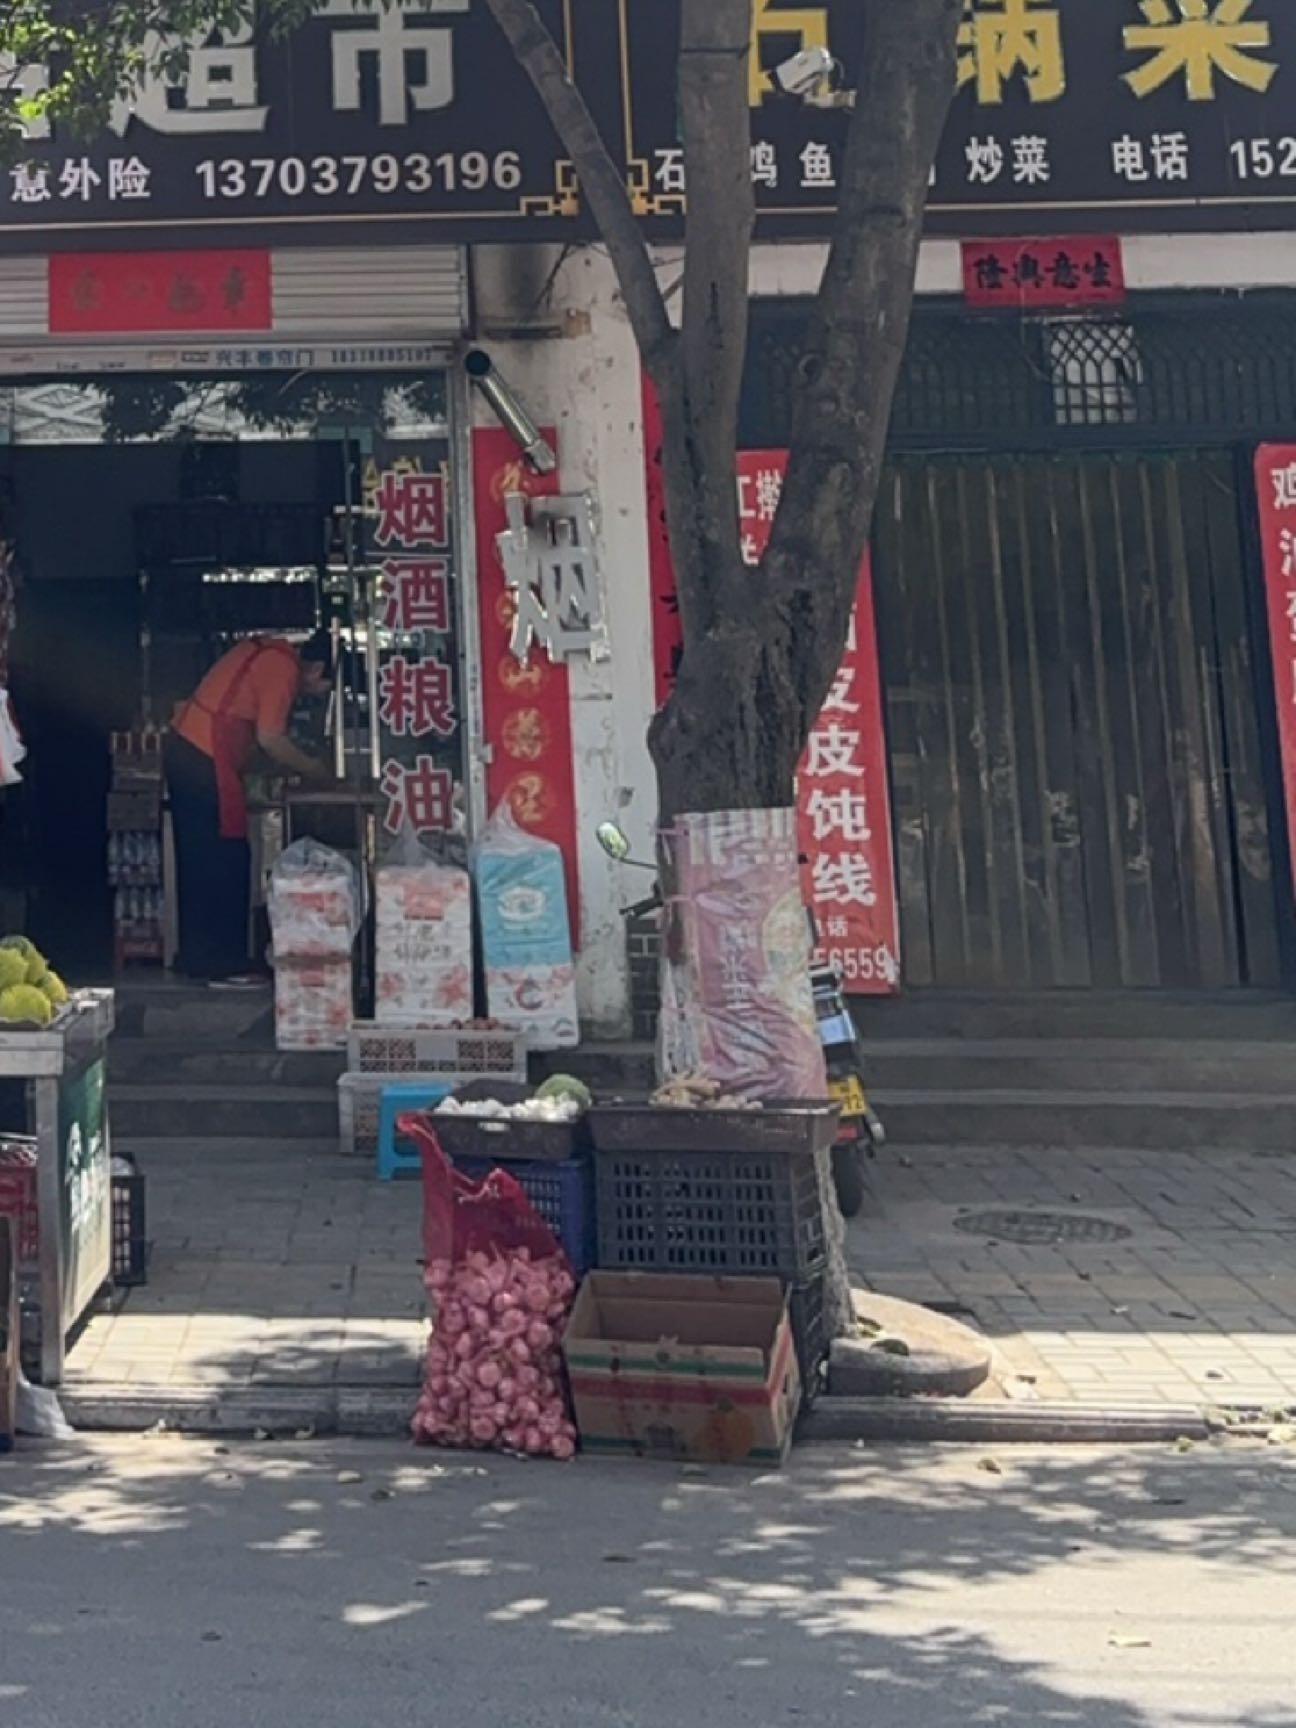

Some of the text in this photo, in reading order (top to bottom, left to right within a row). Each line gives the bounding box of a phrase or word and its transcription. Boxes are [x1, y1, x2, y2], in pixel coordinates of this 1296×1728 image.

[9, 156, 151, 203] 意外险
[196, 151, 522, 198] 13703793196
[799, 142, 836, 187] 鱼
[965, 136, 1051, 184] 炒菜
[1111, 132, 1188, 181] 电话
[1230, 136, 1296, 179] 152
[373, 472, 456, 834] 烟酒粮油
